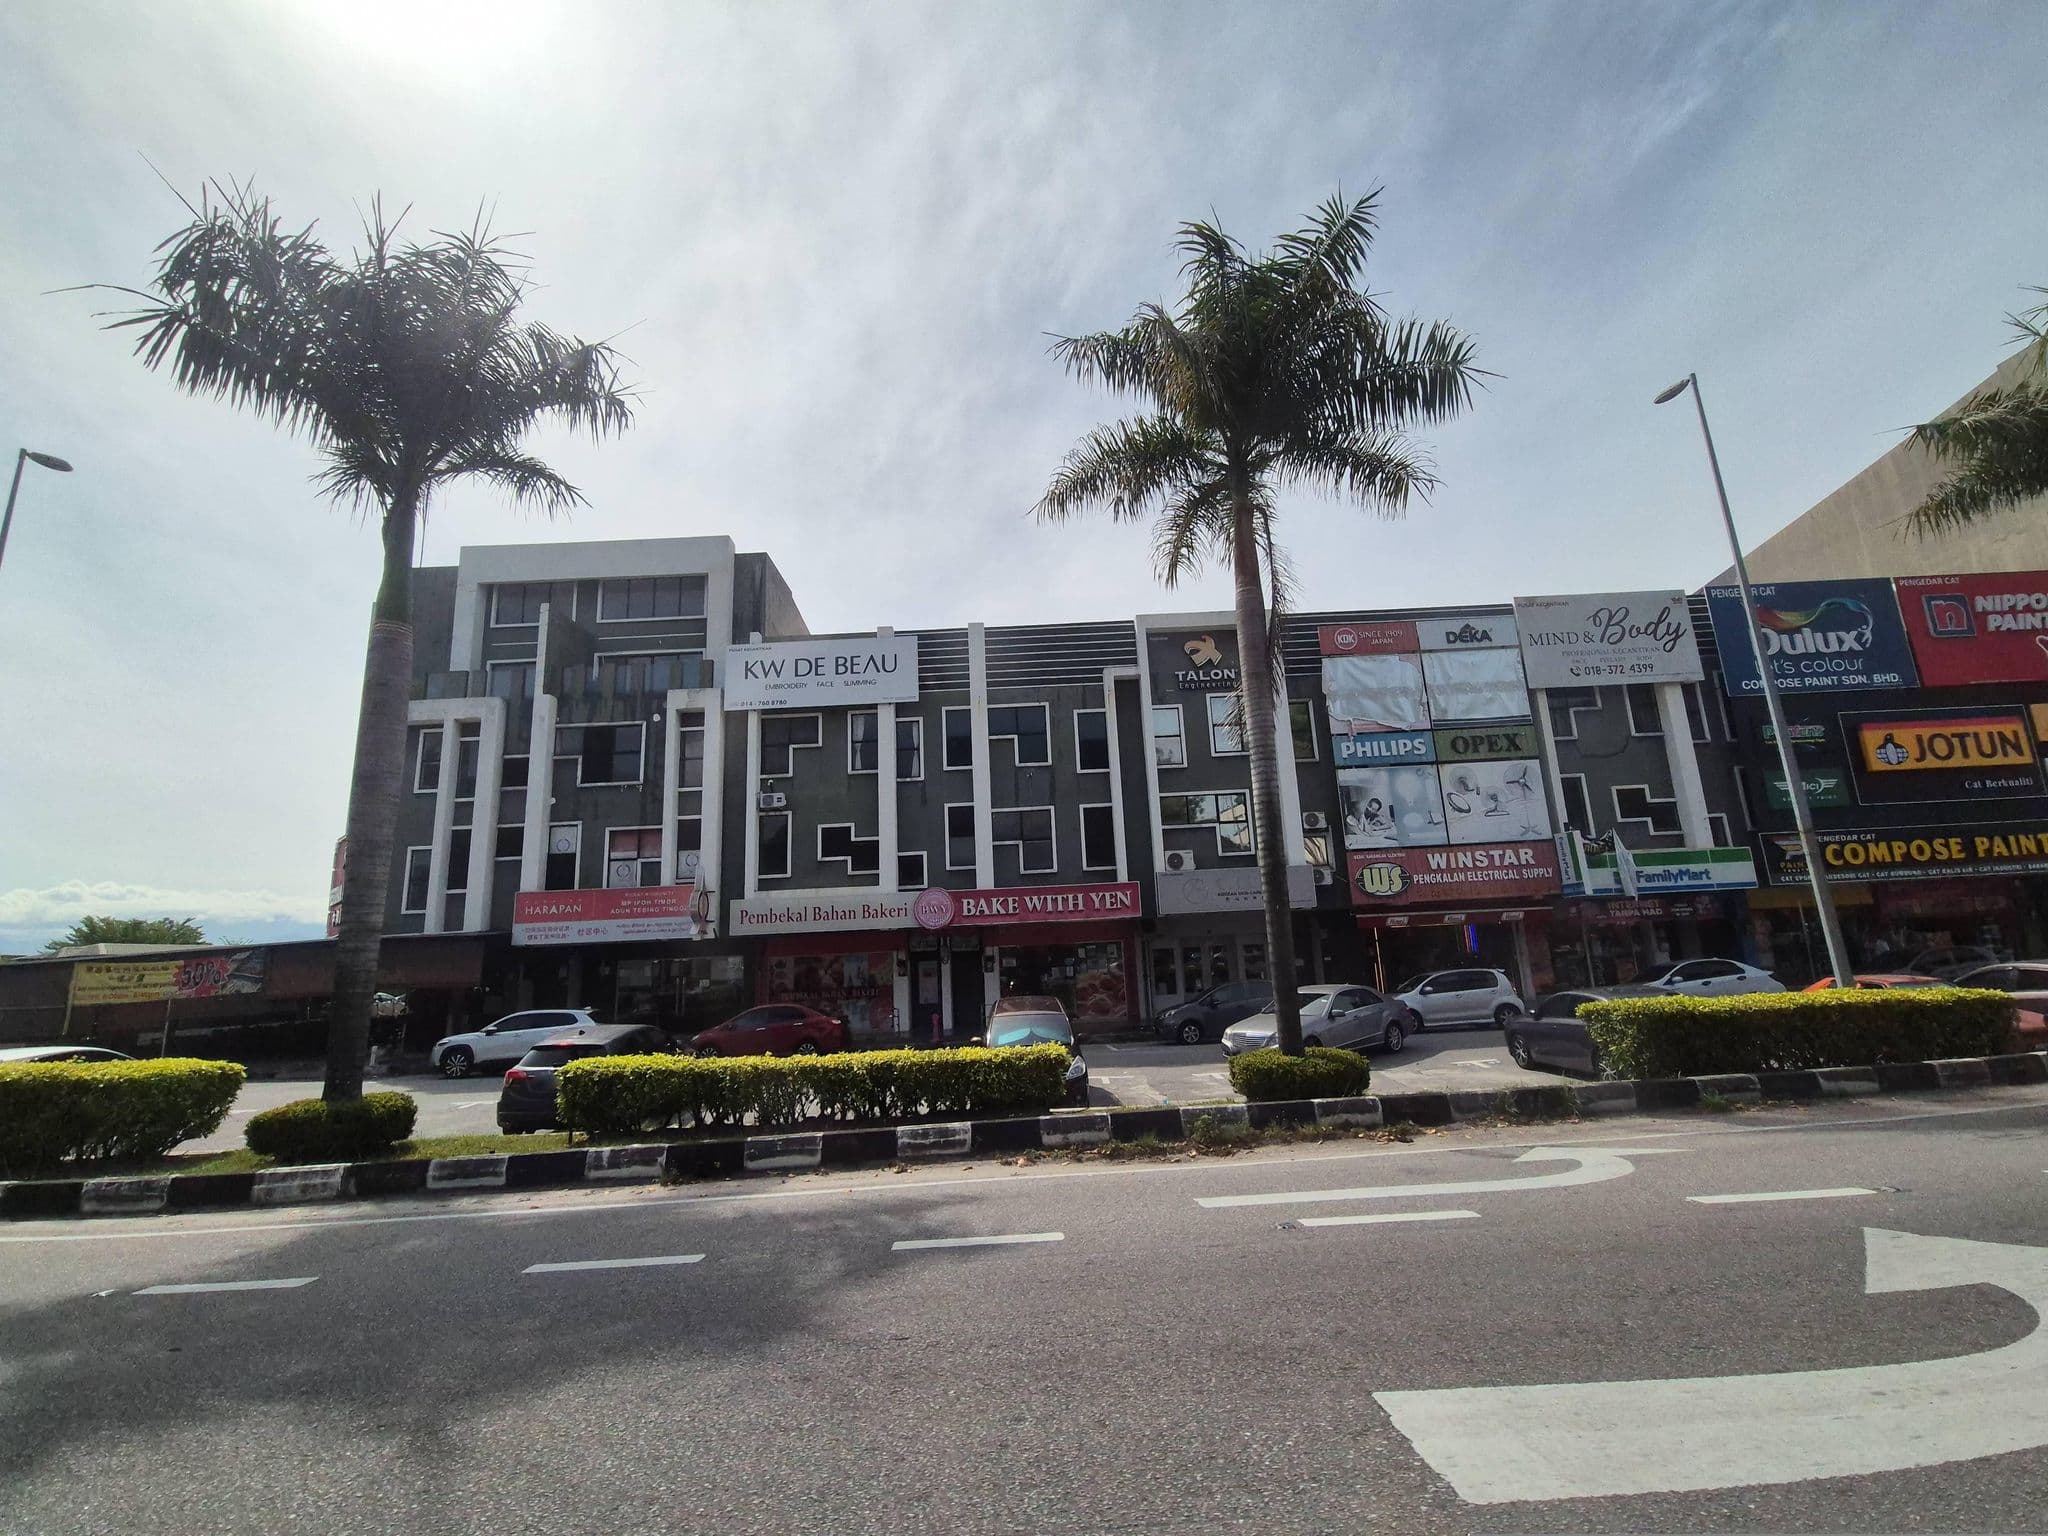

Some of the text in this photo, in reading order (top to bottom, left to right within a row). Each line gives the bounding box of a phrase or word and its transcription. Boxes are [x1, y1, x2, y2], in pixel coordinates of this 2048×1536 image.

[1899, 576, 1960, 586] PENGEDAR CAT
[1711, 586, 1775, 599] PENGER CAT
[1974, 592, 2048, 612] NIPPO
[1358, 631, 1381, 639] SINCE
[1528, 606, 1688, 653] MIND & Body
[1371, 637, 1393, 645] JAPAN
[744, 658, 785, 680] KW
[794, 656, 826, 678] DE
[1584, 664, 1626, 676] 018-372
[1629, 663, 1655, 674] 4399
[1800, 656, 1864, 674] colour
[1174, 668, 1236, 682] TALON
[1804, 675, 1839, 687] PAINT
[1841, 674, 1871, 685] SDN.
[1873, 672, 1903, 684] BHD.
[764, 678, 878, 691] EMBROIDERY FACE SLIMMING
[1180, 680, 1237, 689] Engineering
[1340, 737, 1428, 760] PHILIPS
[1450, 732, 1523, 754] OPEX
[1912, 729, 2025, 763] JOTUN
[1965, 775, 2033, 789] Cat Berkualiti
[1818, 833, 1876, 842] ENGEDAR CAT
[1427, 848, 1536, 870] WINSTAR
[1824, 837, 1967, 866] COMPOSE
[1362, 865, 1403, 894] WS
[1413, 867, 1554, 885] PENGKALAN ELECTRICAL SUPPLY
[1635, 868, 1712, 884] FamilyMart
[525, 904, 582, 915] HARAPAN
[633, 906, 660, 914] TEBING
[962, 890, 1133, 917] BAKE WITH YEN
[739, 902, 909, 925] Pembekal Bahan Bakeri
